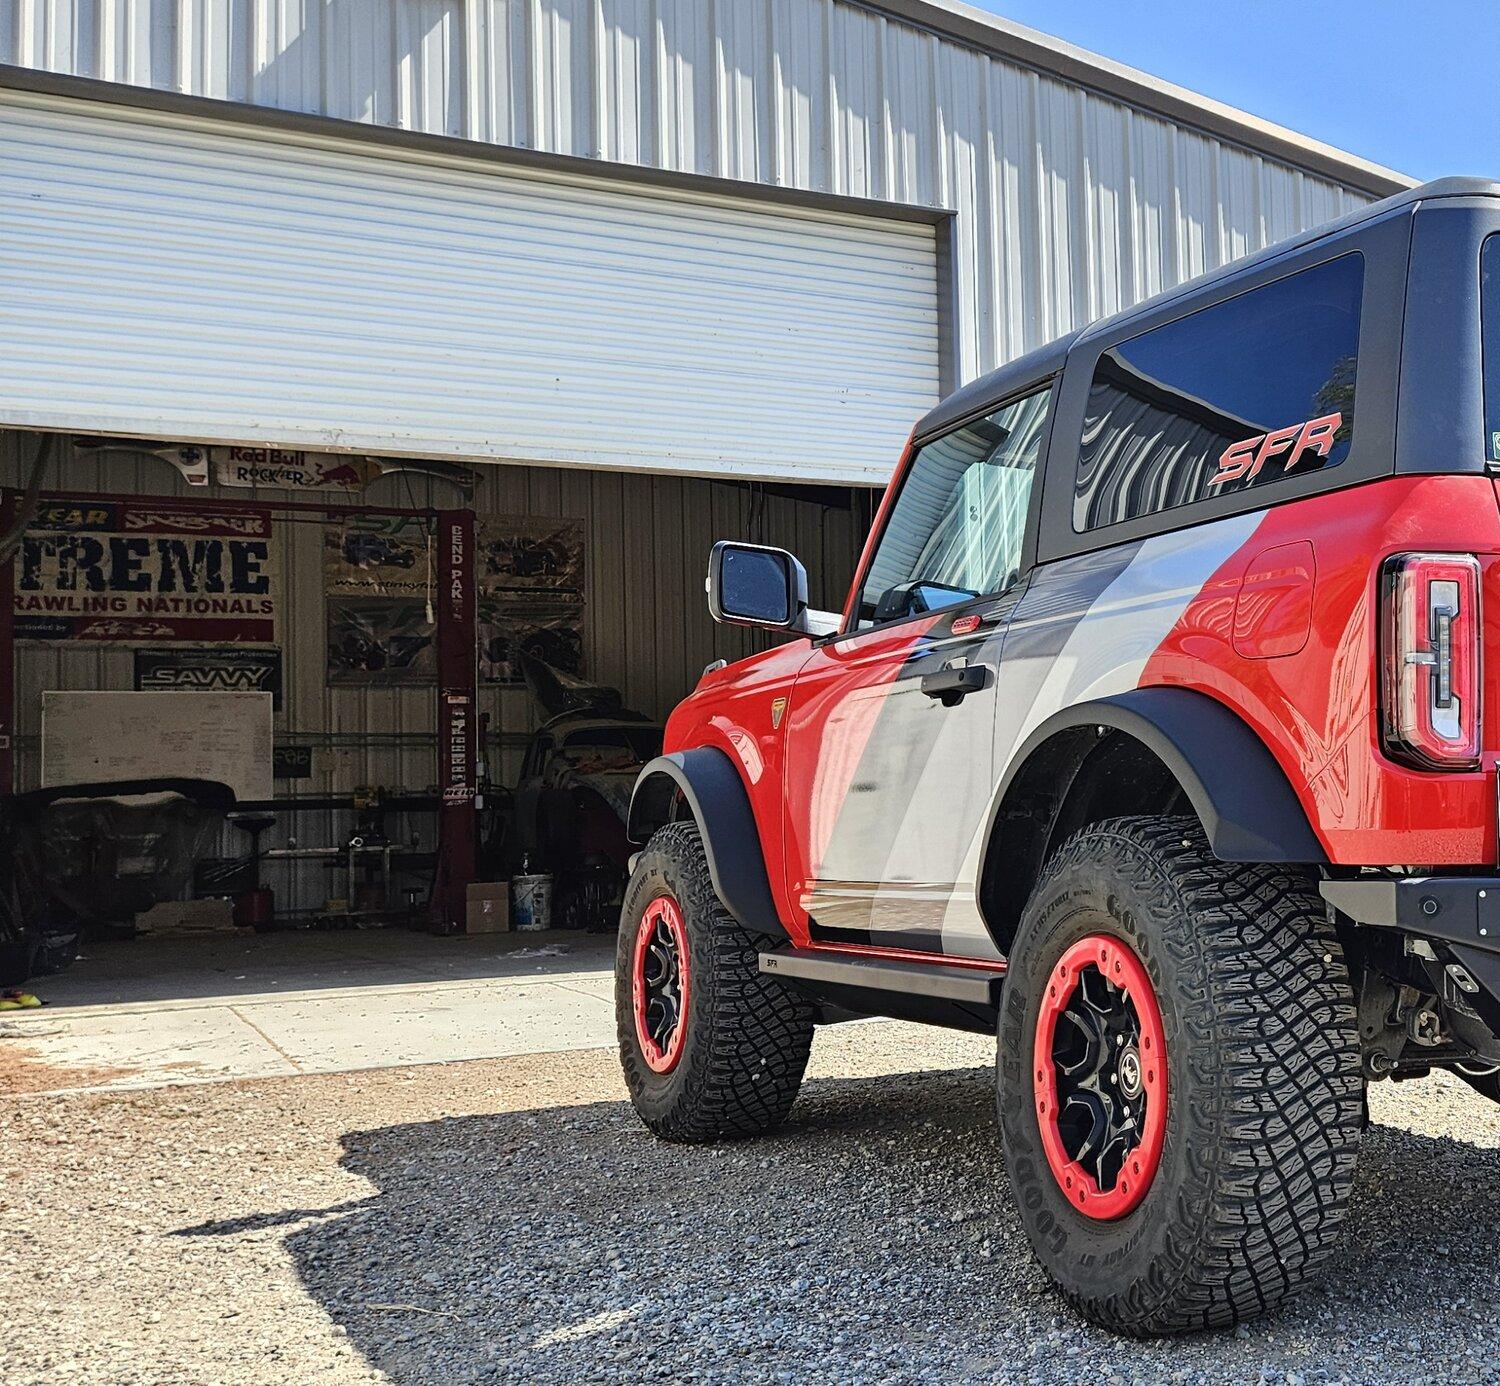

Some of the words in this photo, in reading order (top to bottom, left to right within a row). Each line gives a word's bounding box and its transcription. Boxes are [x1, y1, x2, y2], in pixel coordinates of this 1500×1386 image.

[230, 447, 266, 463] Red
[270, 449, 305, 467] Bull
[1208, 412, 1342, 486] SFR
[451, 525, 463, 564] BEND
[451, 569, 463, 599] PAK
[137, 597, 273, 614] NATIONALS
[155, 667, 271, 684] SAVVY
